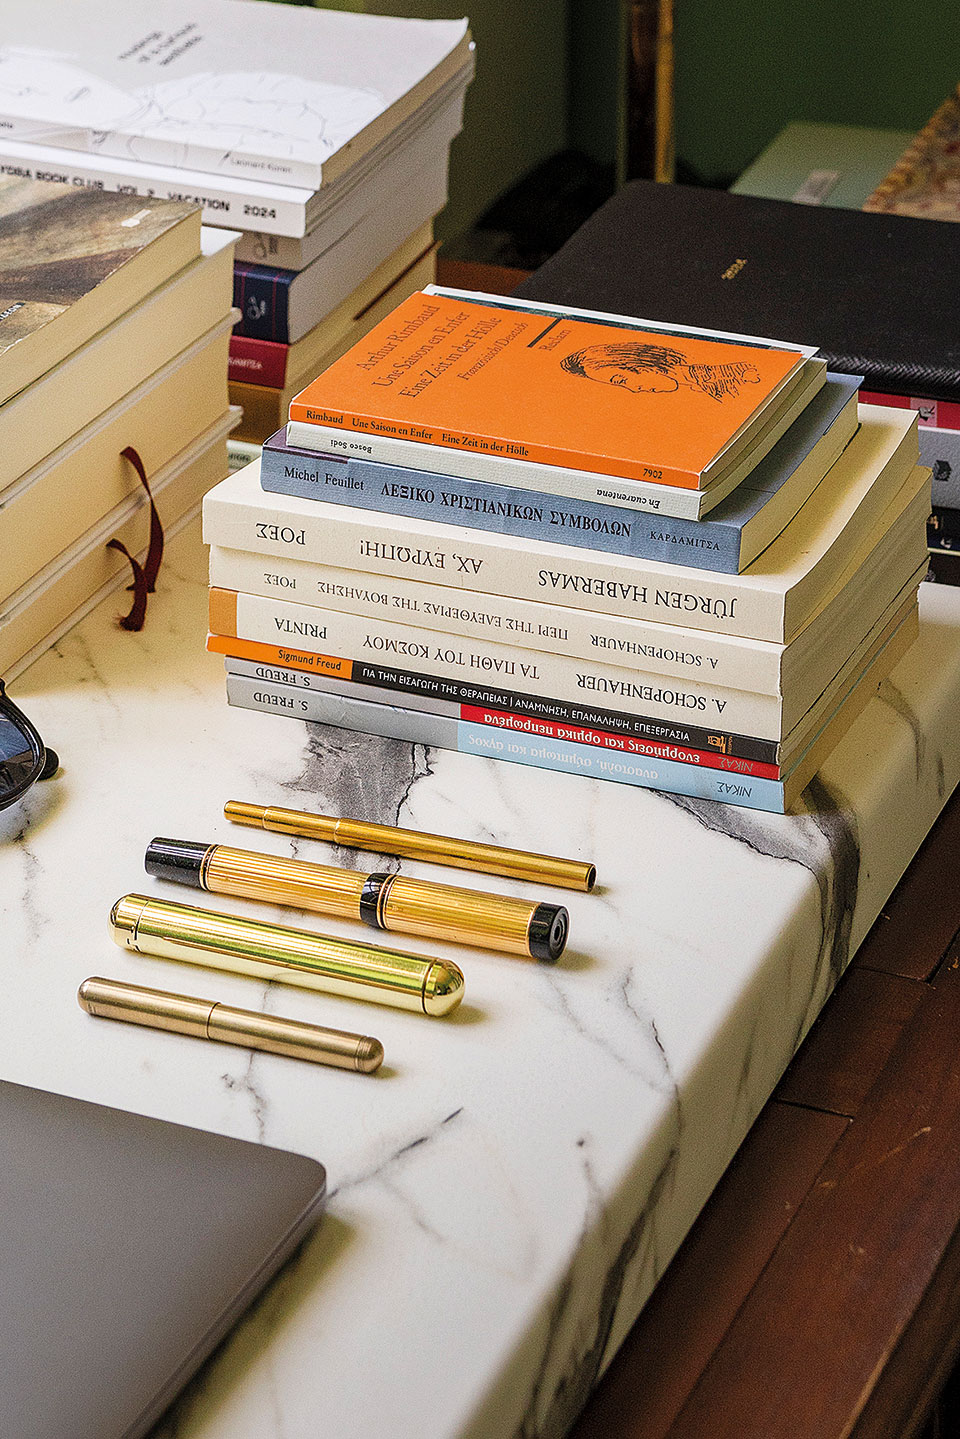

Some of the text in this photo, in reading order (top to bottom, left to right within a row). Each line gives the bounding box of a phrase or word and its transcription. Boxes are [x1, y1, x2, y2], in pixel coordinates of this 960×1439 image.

[36, 170, 69, 184] BOOK
[72, 176, 104, 190] CLUB
[168, 191, 231, 212] VACATION
[243, 203, 277, 219] 2024
[356, 304, 440, 371] Arthur Rimbaud
[371, 311, 470, 387] Une Saison en Enfer
[538, 329, 572, 351] Reclam
[398, 378, 432, 398] Eine
[420, 360, 452, 379] Zeit
[451, 339, 476, 353] der
[465, 317, 502, 340] Hölle
[306, 410, 344, 425] Rimbaud
[352, 417, 433, 440] Une Saison en Enfer
[330, 439, 372, 454] Bosco Sodi
[442, 433, 529, 457] Eine Zeit in der Hölle
[284, 466, 364, 491] Michel Feuillet
[643, 468, 663, 480] 7902
[381, 482, 632, 538] ΛΕΞΙΚΟ ΧΡΙΣΤΙΑΝΙΚΩΝ ΣΥΜΒΟΛΩΝ
[596, 489, 661, 509] En cuarentena
[650, 531, 721, 552] ΚΑΡΔΑΜΙΤΣΑ
[359, 540, 484, 574] ΑΧ, ΕΥΡΩΠΗ!
[538, 570, 738, 620] JÜRGEN HABERMAS
[317, 581, 569, 641] ΠΕΡΙ ΤΗΣ ΕΛΕΥΘΕΡΙΑΣ ΤΗΣ ΒΟΥΛΗΣΗΣ
[274, 617, 328, 640] PRINTA
[278, 649, 342, 671] Sigmund Freud
[362, 635, 540, 680] ΤΑ ΠΑΘΗ ΤΟΥ ΚΟΣΜΟΥ
[590, 634, 719, 670] A. SCHOPENHAUER
[255, 667, 311, 687] S. FREUD
[253, 691, 309, 711] S. FREUD
[362, 667, 690, 742] ΓΙΑ ΤΗΝ ΕΙΣΑΓΩΓΗ ΤΗΣ ΘΕΡΑΠΕΙΑΣ ΑΝΑΜΝΗΣΗ, ΕΠΑΝΑΛΗΨΗ, ΕΠΕΞΕΡΓΑΣΙΑ
[576, 673, 727, 713] A. SCHOPENHAUER
[468, 734, 504, 753] άγχος
[484, 714, 700, 763] ενορμήσεις και ορμικά πεπρωμένα
[507, 743, 527, 755] και
[530, 748, 592, 768] σύμπτωμα
[717, 756, 754, 773] ΝΙΚΑΣ
[716, 781, 752, 797] ΝΙΚΑΣ
